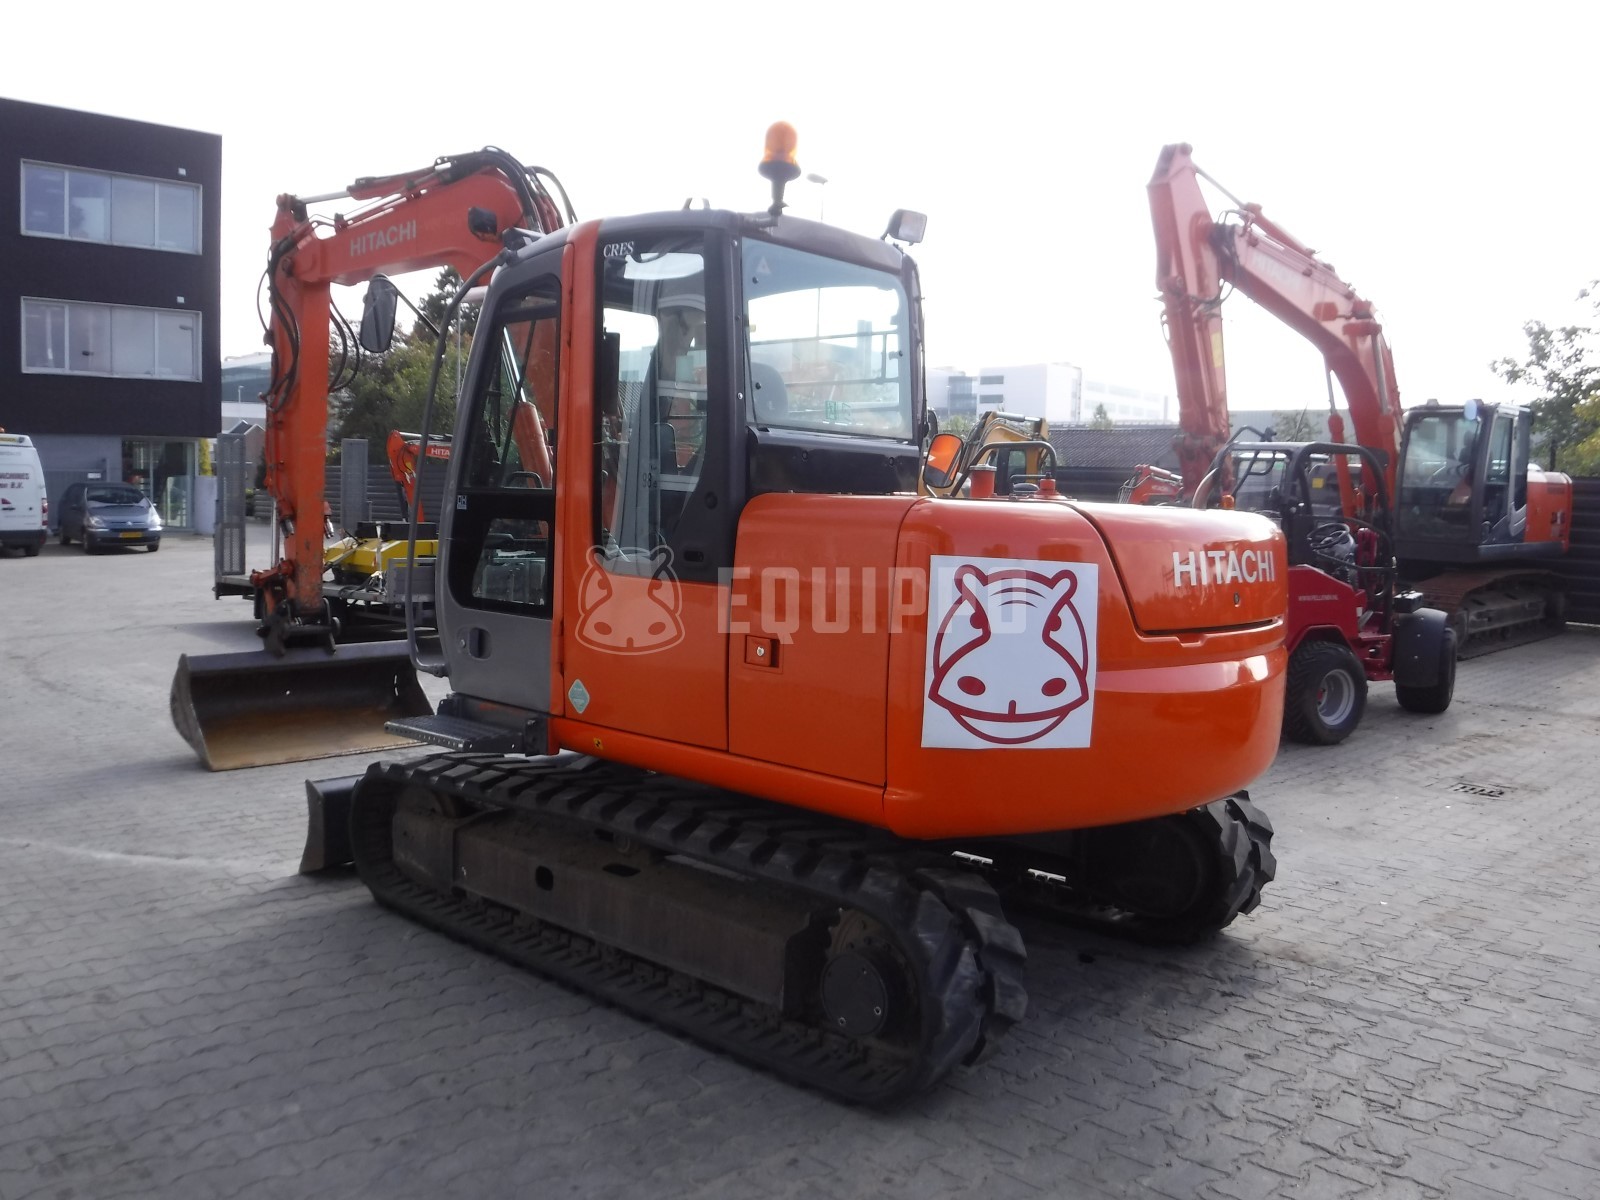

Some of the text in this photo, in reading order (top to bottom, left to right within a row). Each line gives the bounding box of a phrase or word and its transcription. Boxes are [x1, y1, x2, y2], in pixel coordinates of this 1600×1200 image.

[350, 220, 417, 257] HITACHI
[603, 241, 634, 257] CRES
[431, 448, 450, 456] HITA
[1172, 549, 1275, 587] HITACHI
